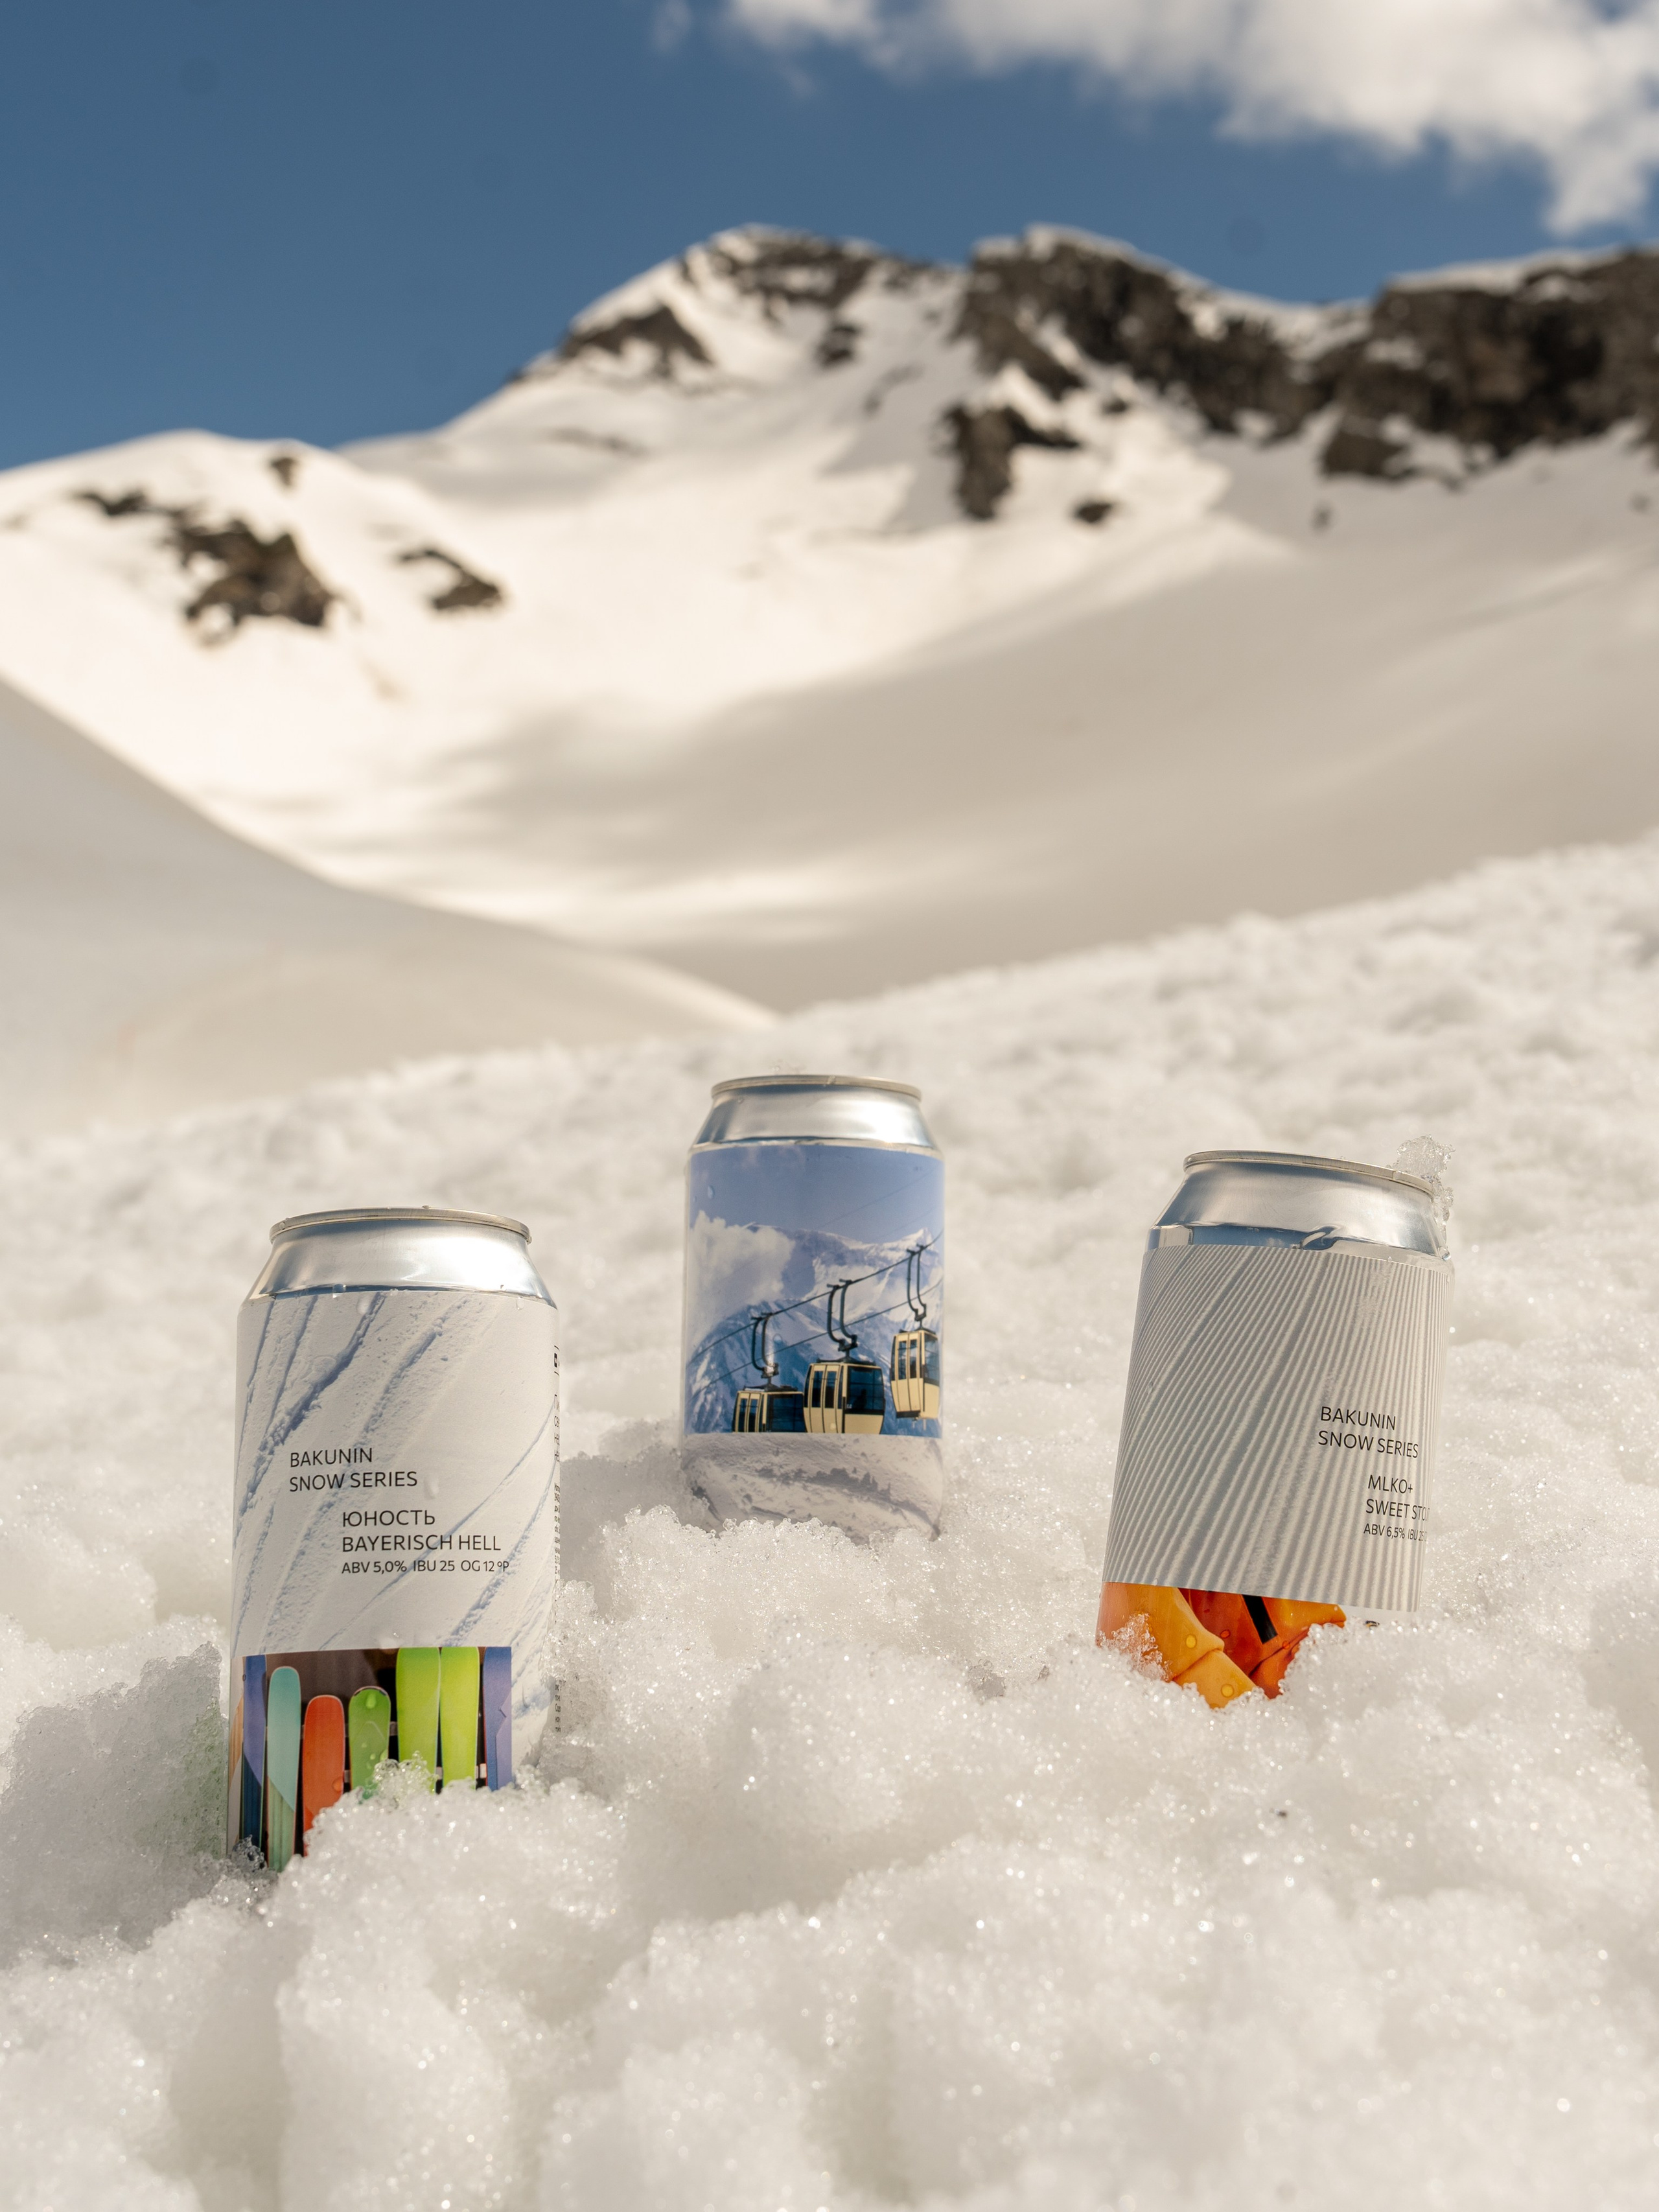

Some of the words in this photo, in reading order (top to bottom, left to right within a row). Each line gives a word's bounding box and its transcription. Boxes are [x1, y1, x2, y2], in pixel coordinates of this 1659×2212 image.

[1320, 1406, 1396, 1430] BAKUNIN
[1318, 1430, 1374, 1451] SNOW
[1377, 1438, 1419, 1458] SERIES
[290, 1448, 373, 1467] BAKUNIN
[290, 1473, 345, 1492] SNOW
[350, 1471, 418, 1487] SERIES
[1367, 1474, 1413, 1494] MLKO+
[342, 1509, 435, 1527] ЮНОСТЬ
[1365, 1498, 1410, 1519] SWEET
[1363, 1523, 1385, 1536] ABV
[1386, 1526, 1406, 1539] 6,5%
[1408, 1528, 1418, 1541] IBU
[342, 1535, 452, 1552] BAYERISCH
[458, 1535, 501, 1550] HELL
[342, 1561, 370, 1574] ABV
[373, 1561, 407, 1574] 5,0%
[413, 1561, 436, 1572] IBU
[439, 1561, 455, 1572] 25
[461, 1560, 480, 1572] OG
